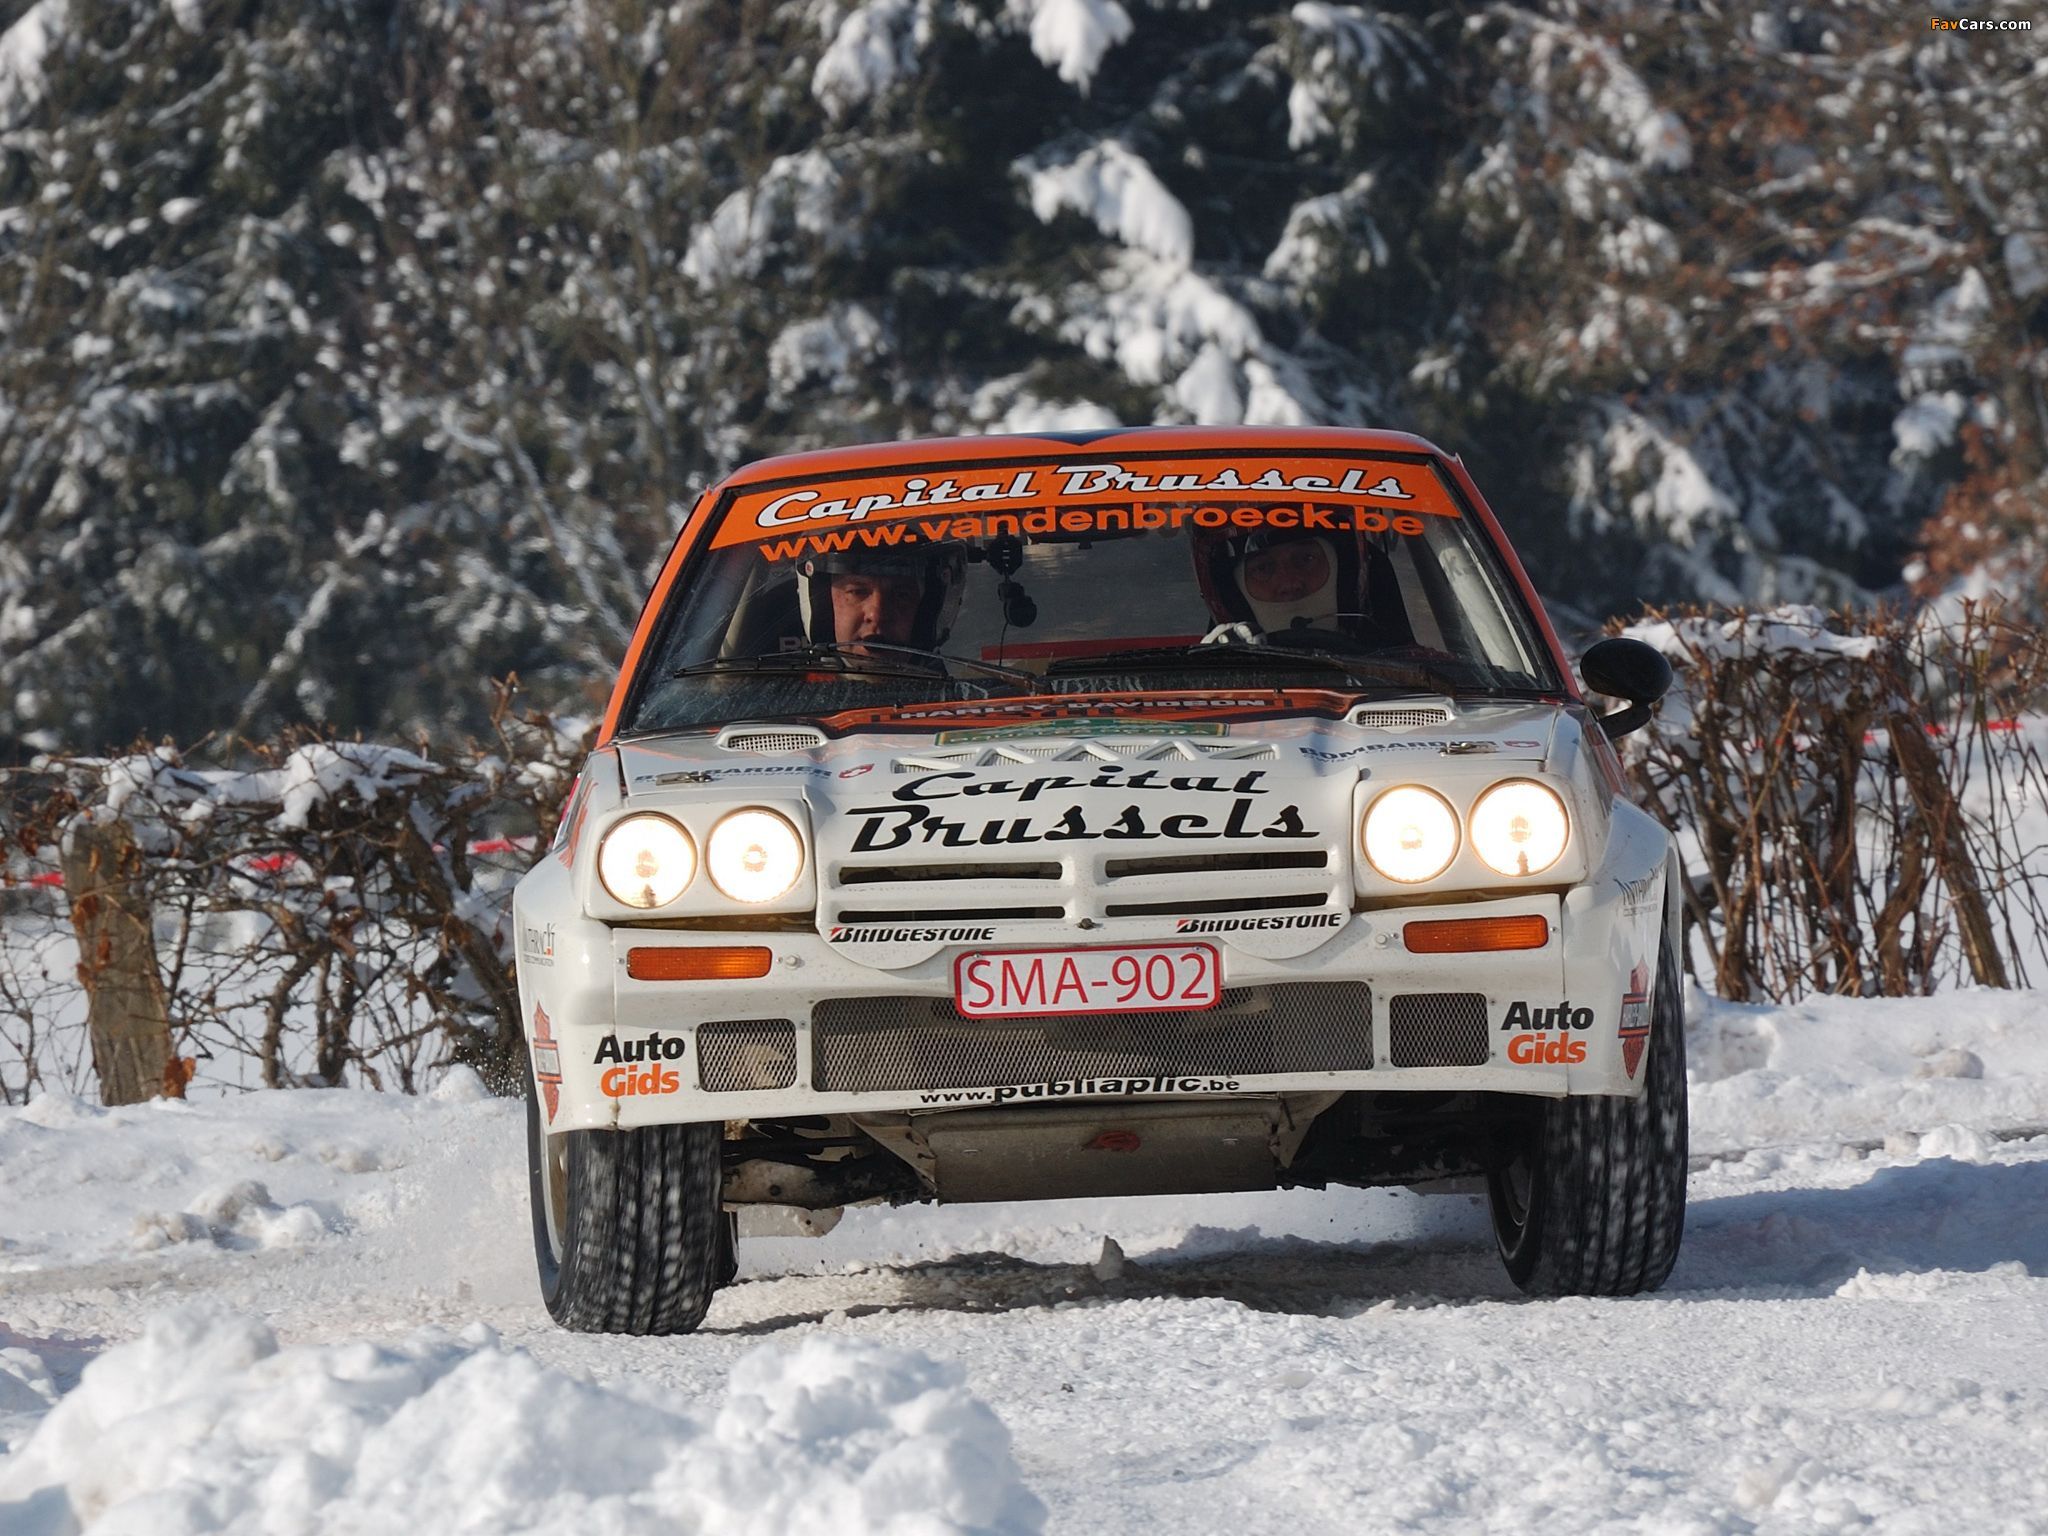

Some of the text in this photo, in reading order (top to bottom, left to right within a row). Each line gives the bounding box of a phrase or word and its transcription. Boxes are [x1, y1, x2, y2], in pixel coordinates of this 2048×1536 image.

[756, 463, 1414, 528] Capital Brussels
[759, 502, 1424, 562] www.vandenbroeck.be
[634, 766, 833, 783] BBARDIER
[892, 765, 1269, 802] Capital
[845, 798, 1320, 852] Brussels
[829, 926, 996, 943] BRIDGESTONE
[1176, 912, 1342, 934] BRIDGESTONE
[967, 952, 1209, 1009] SMA-902
[1501, 1000, 1594, 1031] Auto
[594, 1032, 685, 1064] Auto
[1507, 1031, 1587, 1065] Gids
[600, 1063, 680, 1098] Gids
[920, 1075, 1240, 1104] www.publiaplic.be
